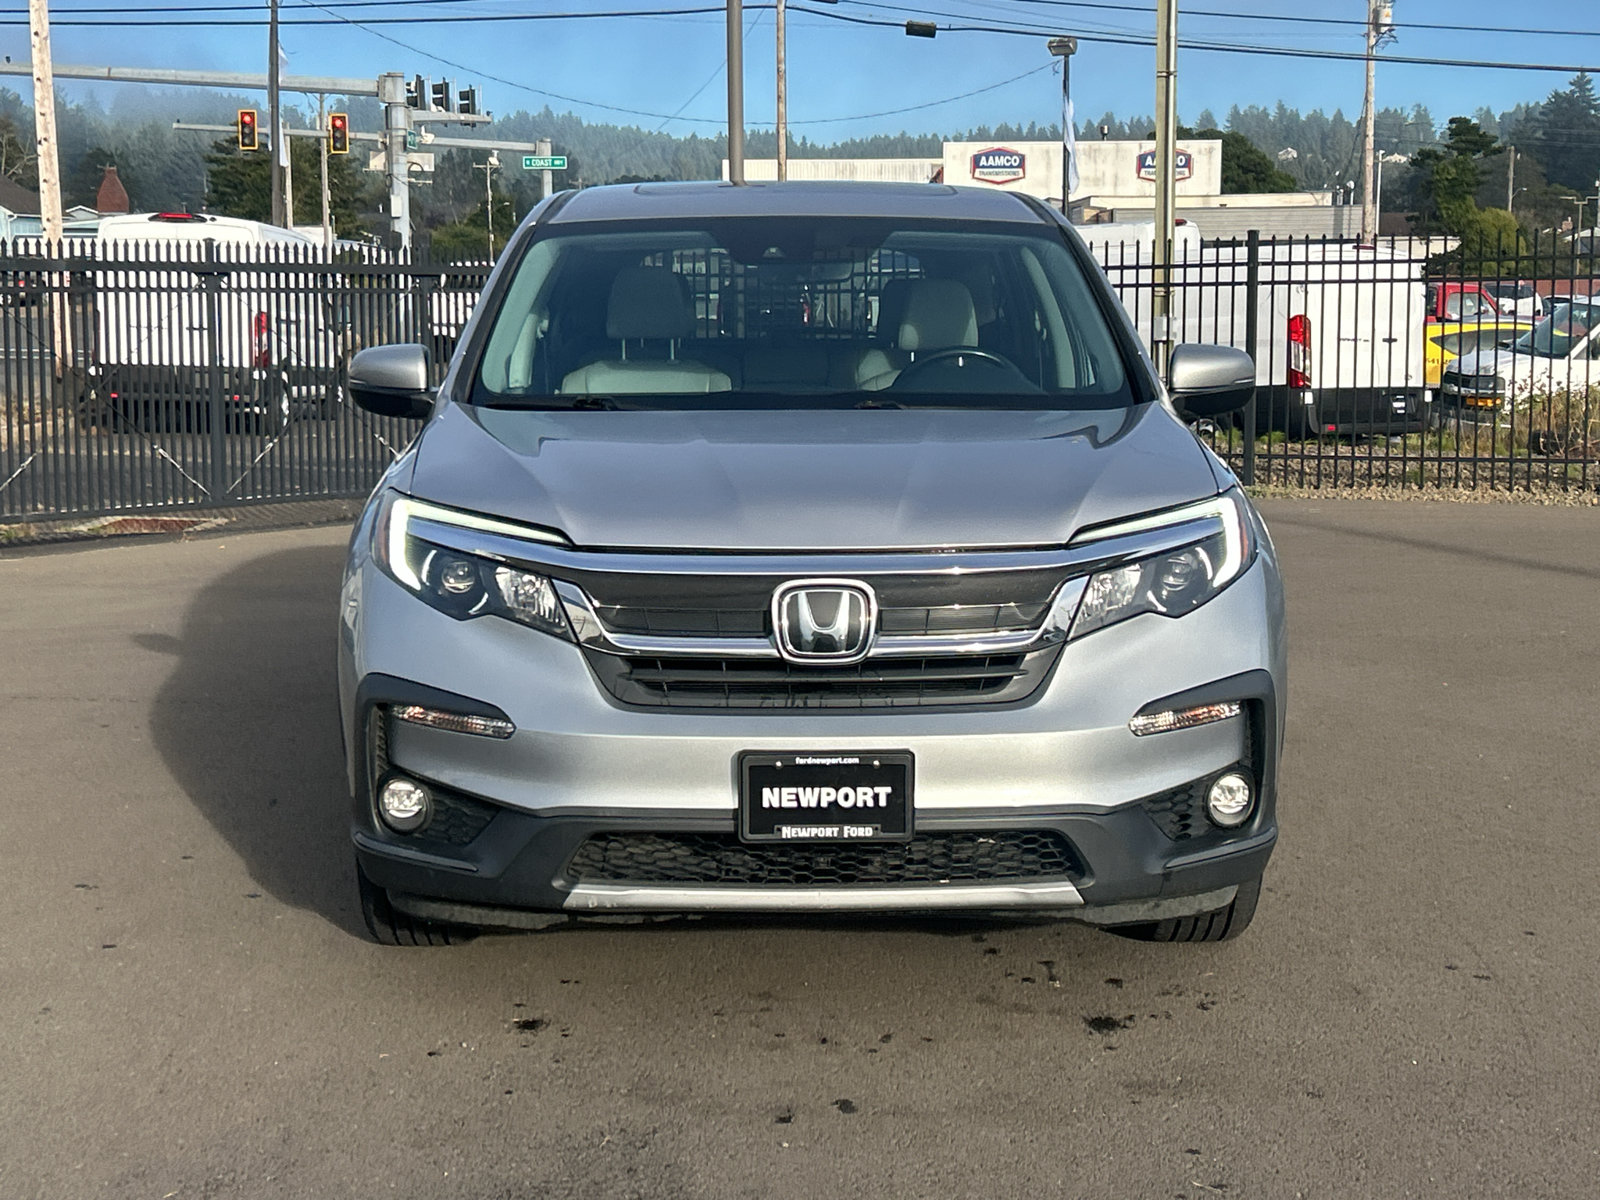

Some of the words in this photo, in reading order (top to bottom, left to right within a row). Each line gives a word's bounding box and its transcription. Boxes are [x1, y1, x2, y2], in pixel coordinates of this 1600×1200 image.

[531, 158, 552, 167] COAST
[979, 156, 1020, 167] AAMCO
[795, 756, 860, 766] fordnewport.com
[761, 786, 892, 809] NEWPORT
[781, 826, 840, 839] NEWPORT
[843, 825, 874, 839] FORD
